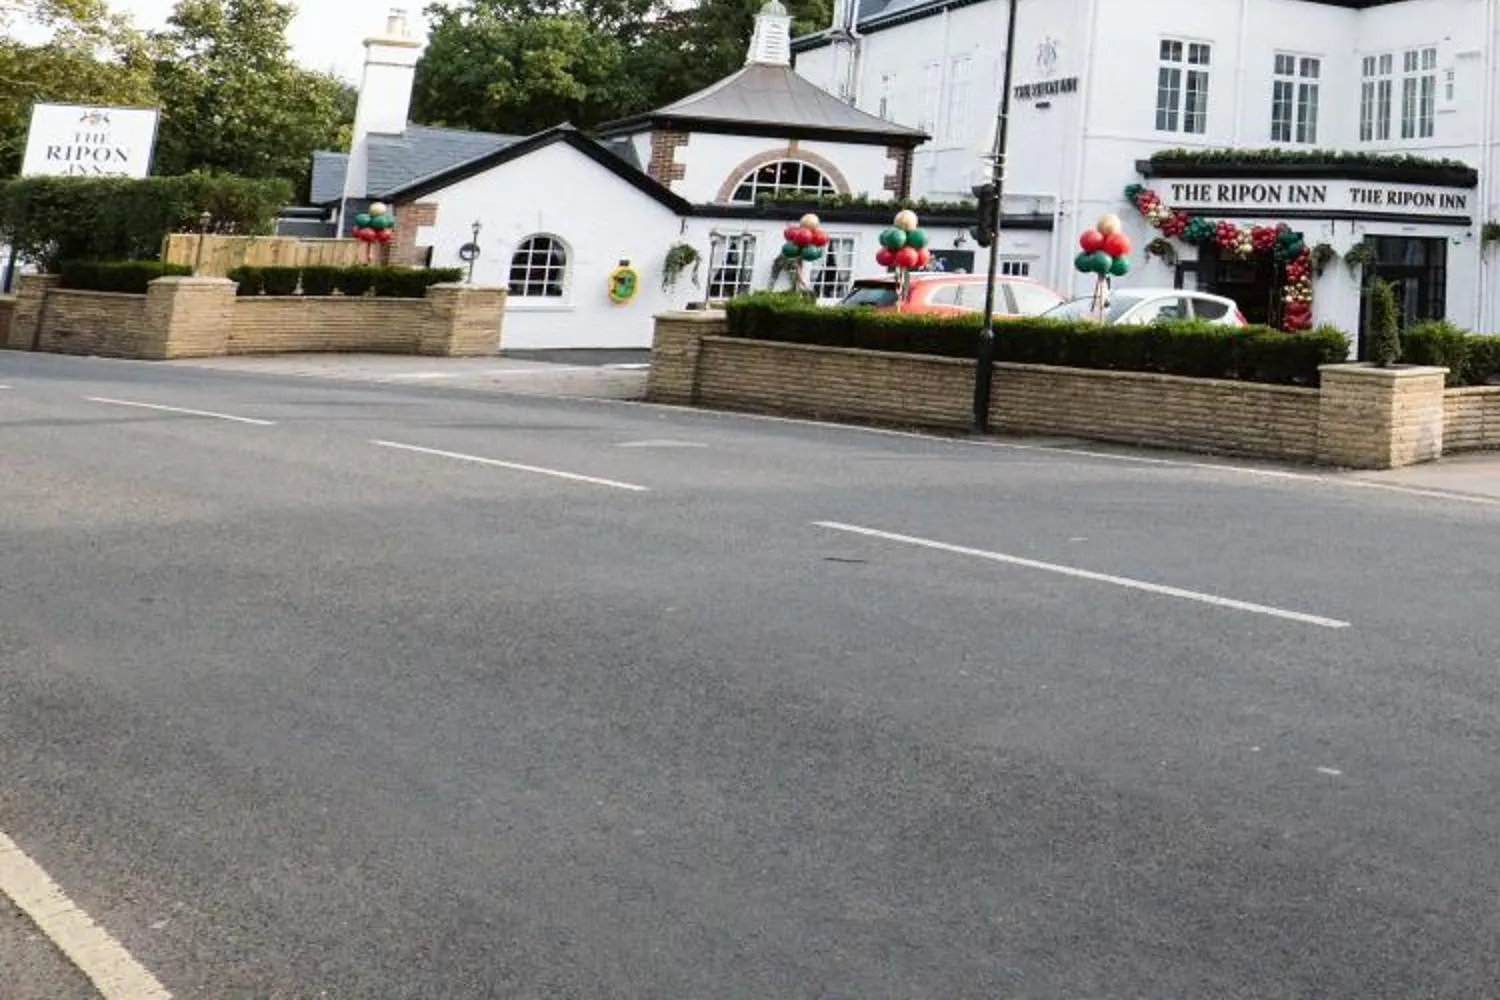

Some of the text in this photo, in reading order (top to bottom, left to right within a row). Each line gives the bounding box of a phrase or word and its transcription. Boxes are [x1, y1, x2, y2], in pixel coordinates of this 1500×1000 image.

[47, 145, 130, 162] RIPON
[1172, 183, 1327, 203] THE RIPON INN
[1350, 188, 1467, 209] THE RIPON INN
